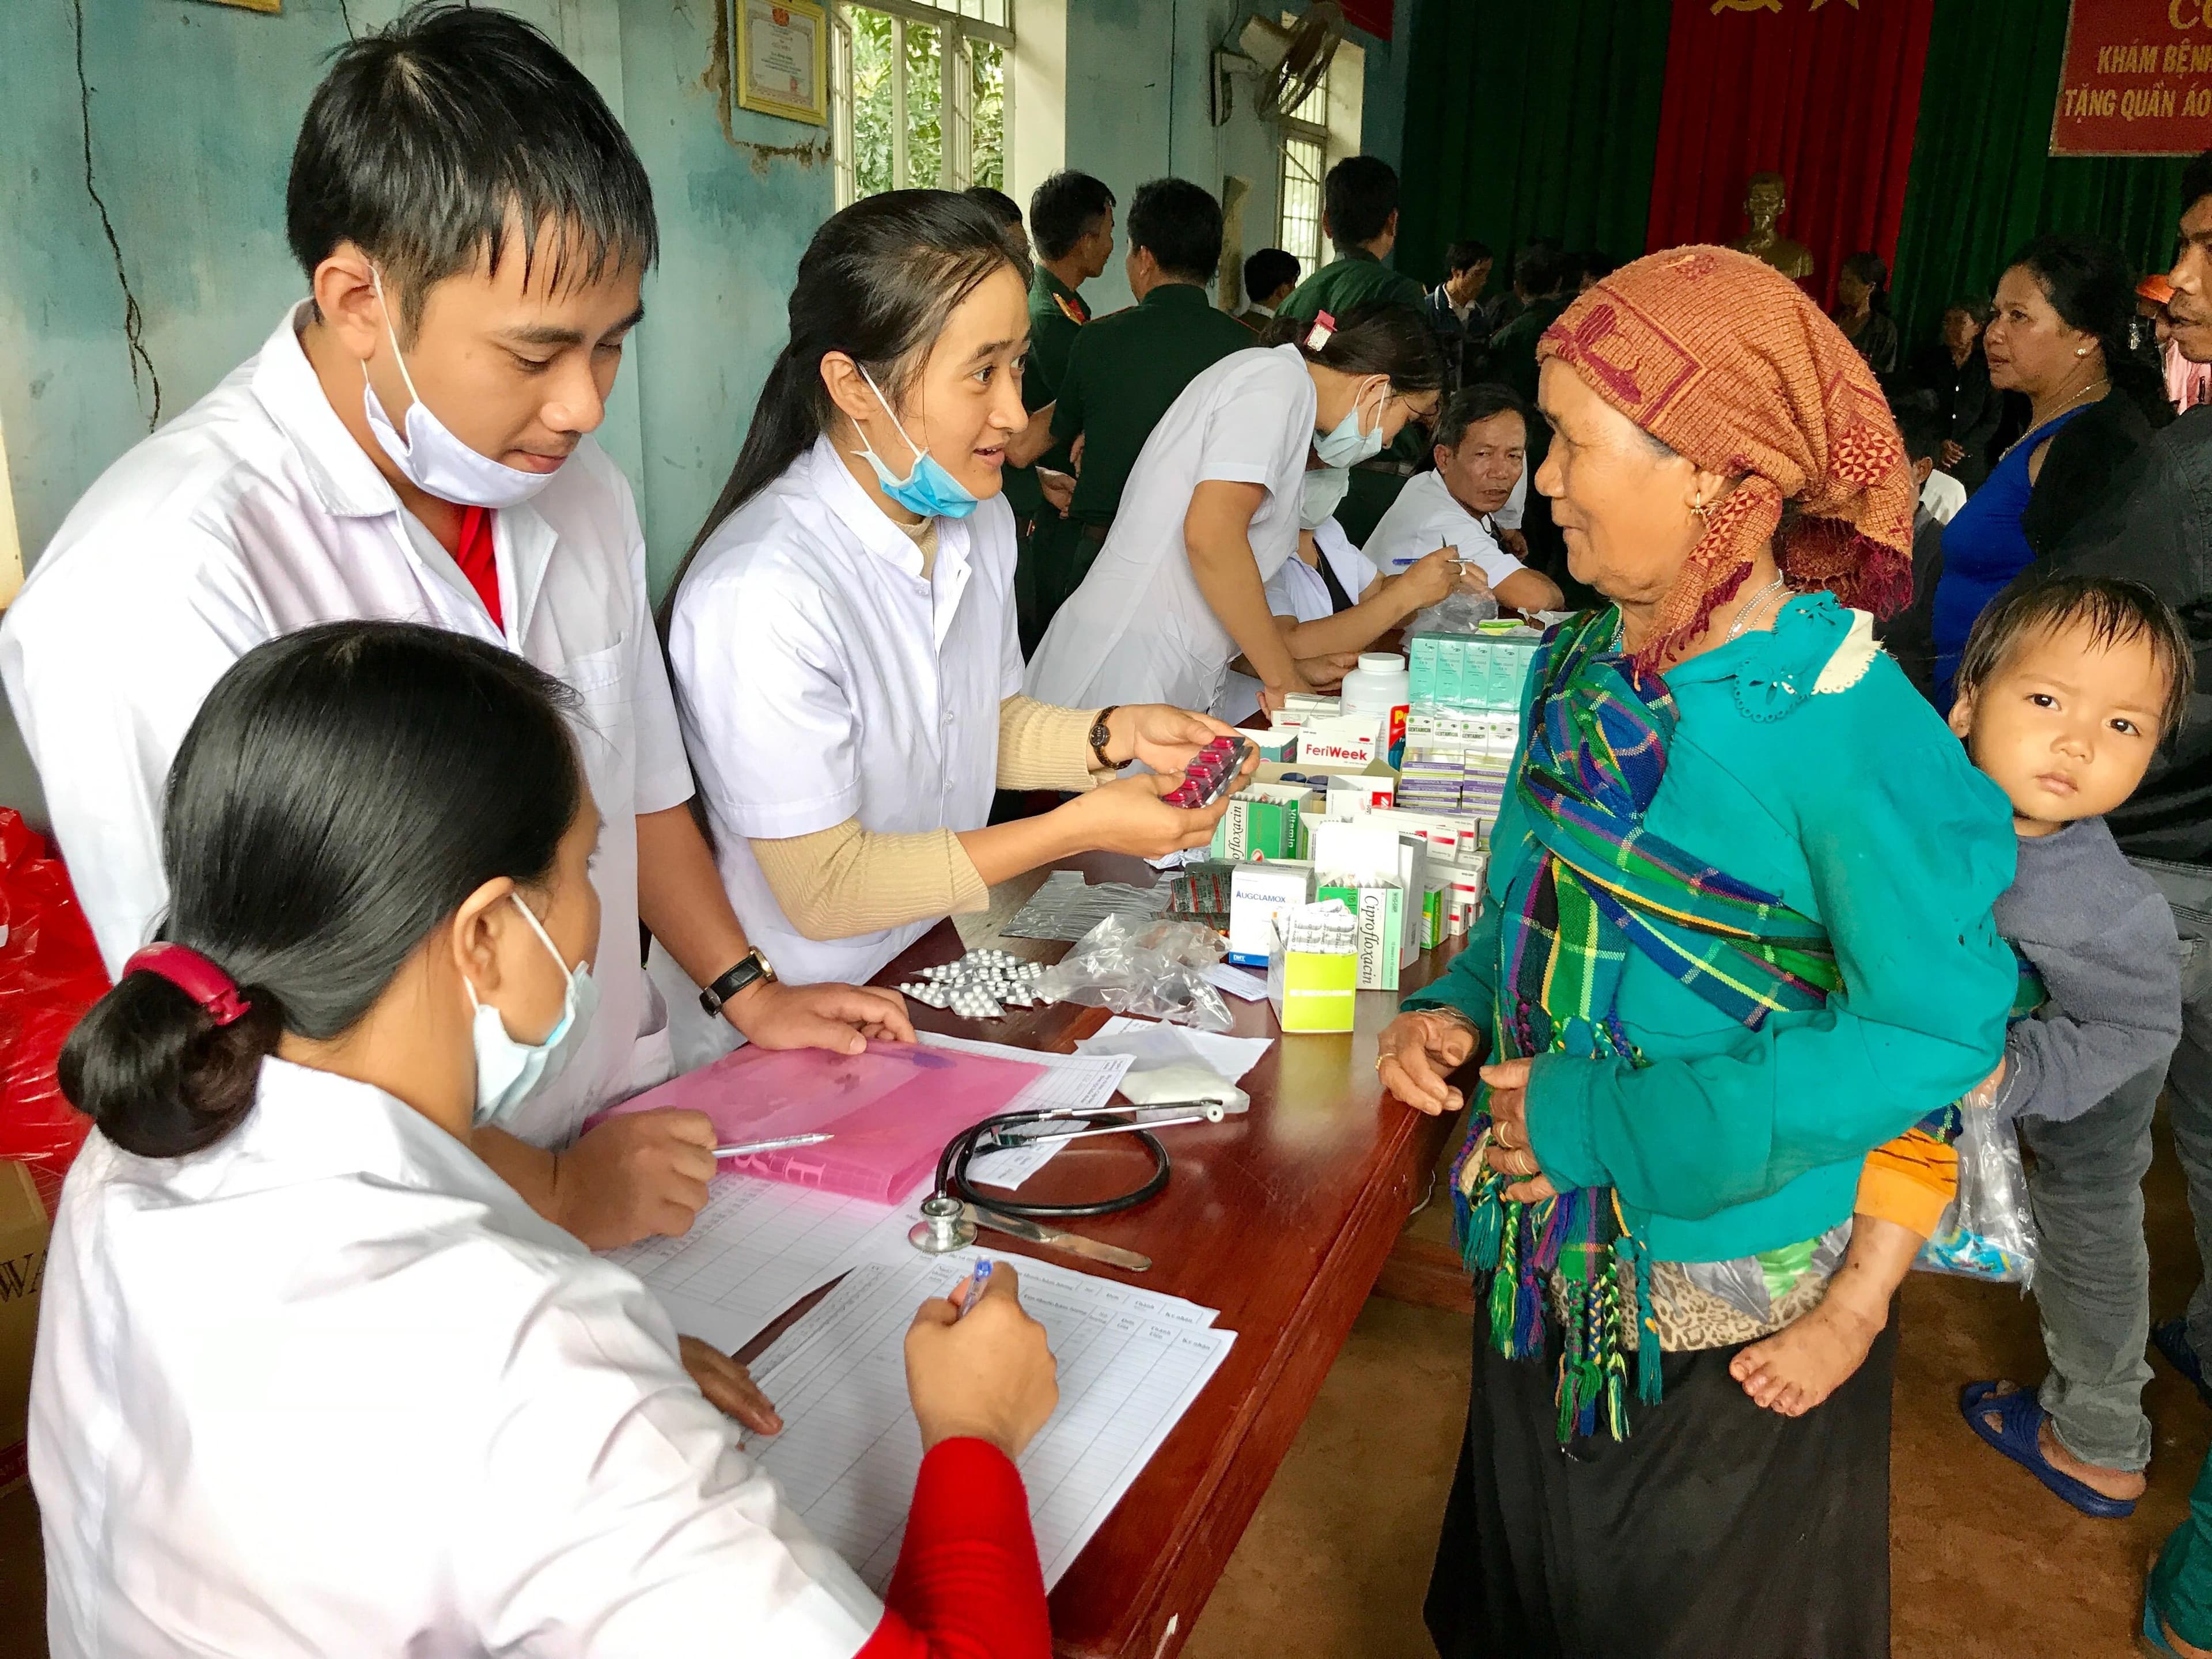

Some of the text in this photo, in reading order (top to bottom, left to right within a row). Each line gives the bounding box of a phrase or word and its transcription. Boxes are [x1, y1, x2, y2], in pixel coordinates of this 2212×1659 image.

[2097, 38, 2158, 74] KHÁM
[2065, 80, 2212, 123] TẶNG QUẦN ÁO
[1306, 744, 1368, 761] FeriWeek
[1228, 806, 1244, 861] ofloxacin
[1288, 808, 1297, 849] Vitamin
[1236, 890, 1286, 903] AUGCLAMOX
[1360, 895, 1380, 985] Ciprofloxacin
